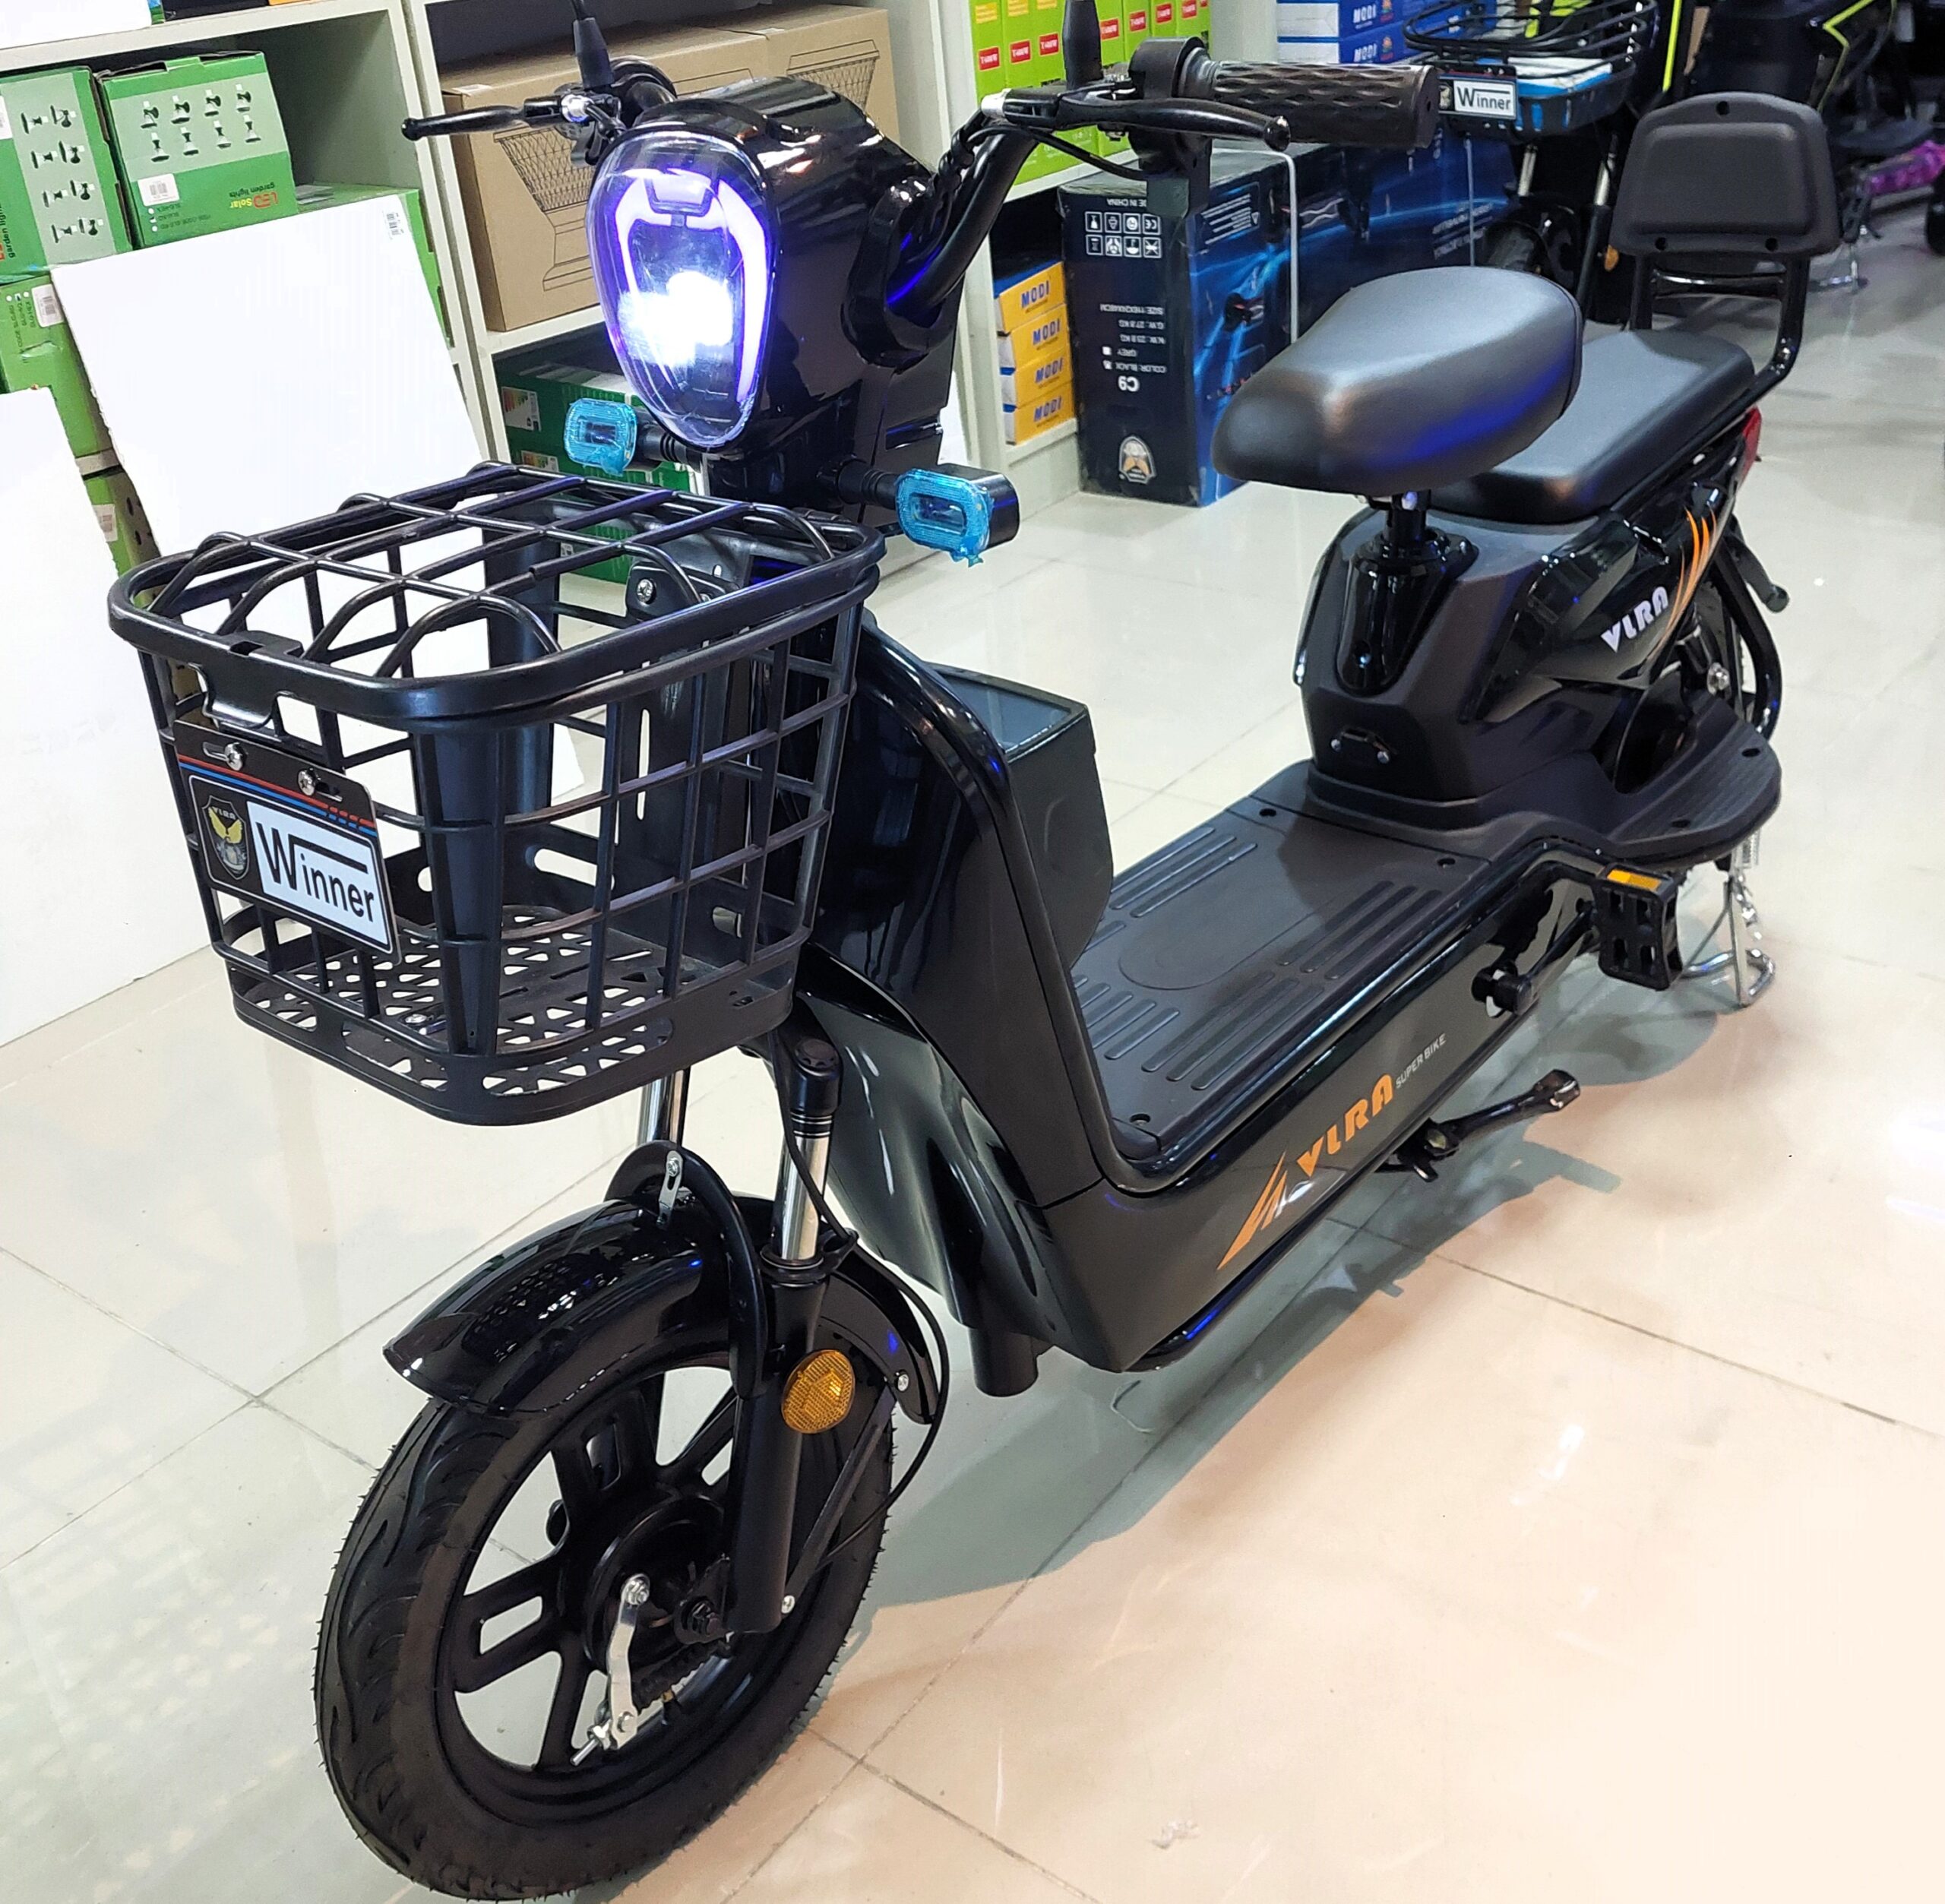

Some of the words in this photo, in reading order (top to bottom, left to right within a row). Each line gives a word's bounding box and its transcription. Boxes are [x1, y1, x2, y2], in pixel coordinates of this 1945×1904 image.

[1456, 86, 1510, 110] Winner
[251, 182, 275, 192] garden
[229, 198, 252, 208] Solar
[2, 228, 16, 258] garden
[1021, 280, 1050, 308] MODI
[1033, 318, 1061, 346] MODI
[1035, 357, 1064, 384] MODI
[1118, 375, 1140, 392] C9
[1033, 396, 1062, 422] MODI
[255, 821, 375, 922] Winner
[1396, 1053, 1424, 1089] SUPER
[1424, 1033, 1447, 1059] BIKE
